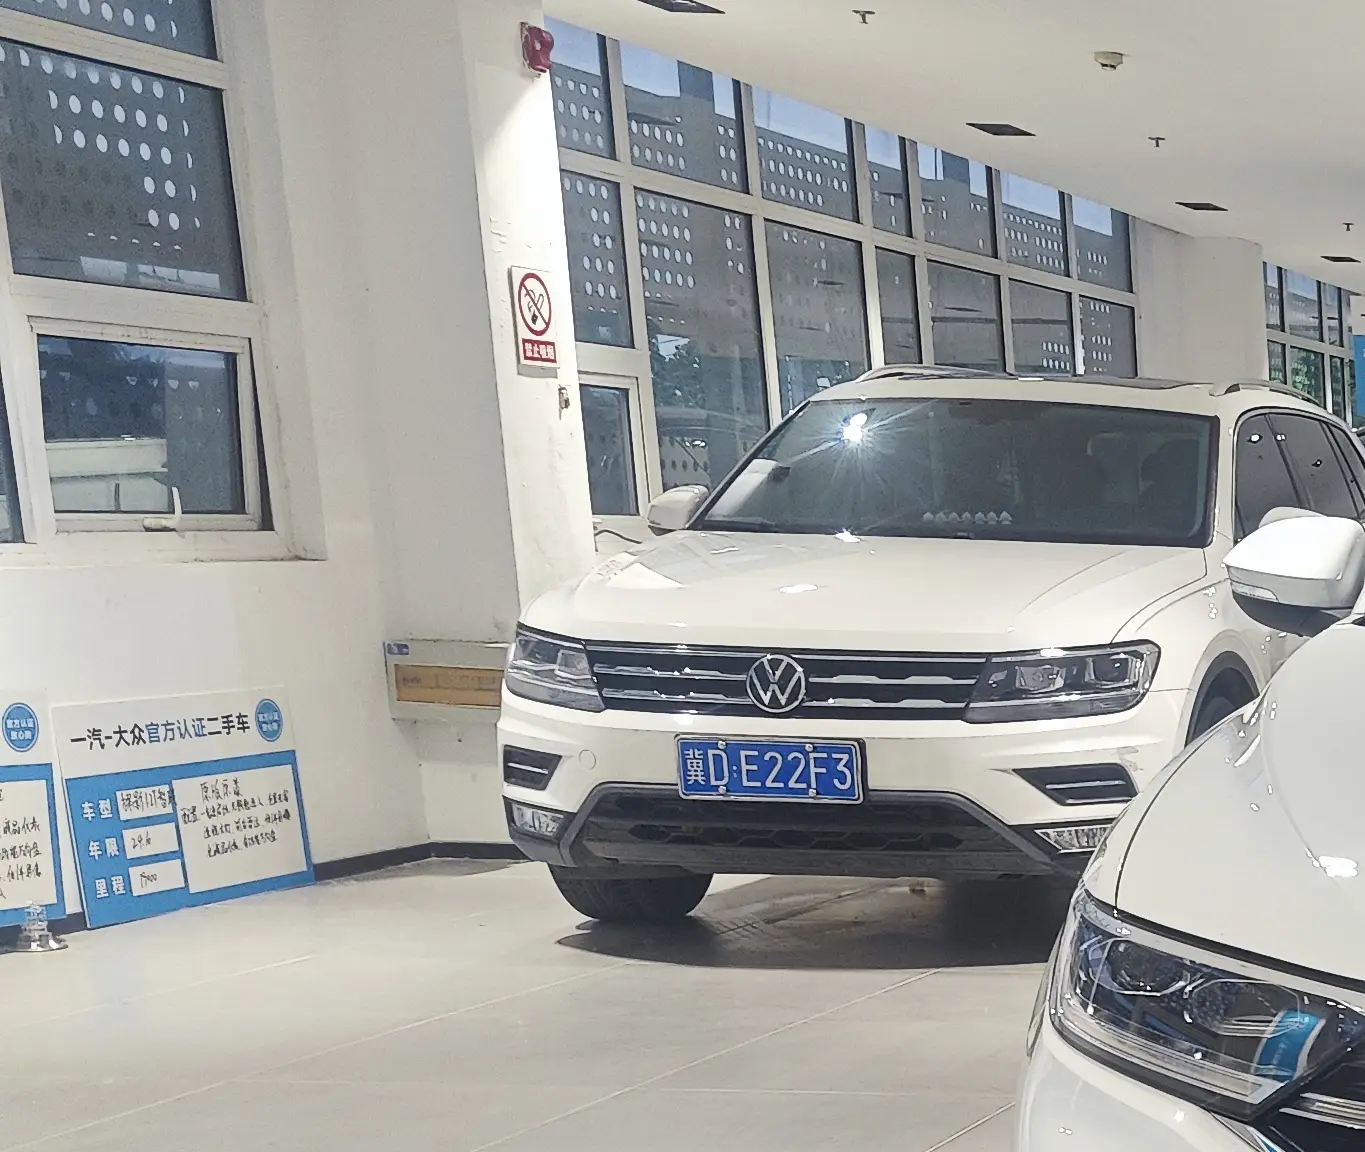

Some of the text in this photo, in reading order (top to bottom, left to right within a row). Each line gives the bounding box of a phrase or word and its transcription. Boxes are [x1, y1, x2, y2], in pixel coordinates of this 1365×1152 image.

[70, 712, 251, 751] 一汽-大众官方认证二手车
[82, 798, 113, 821] 车型
